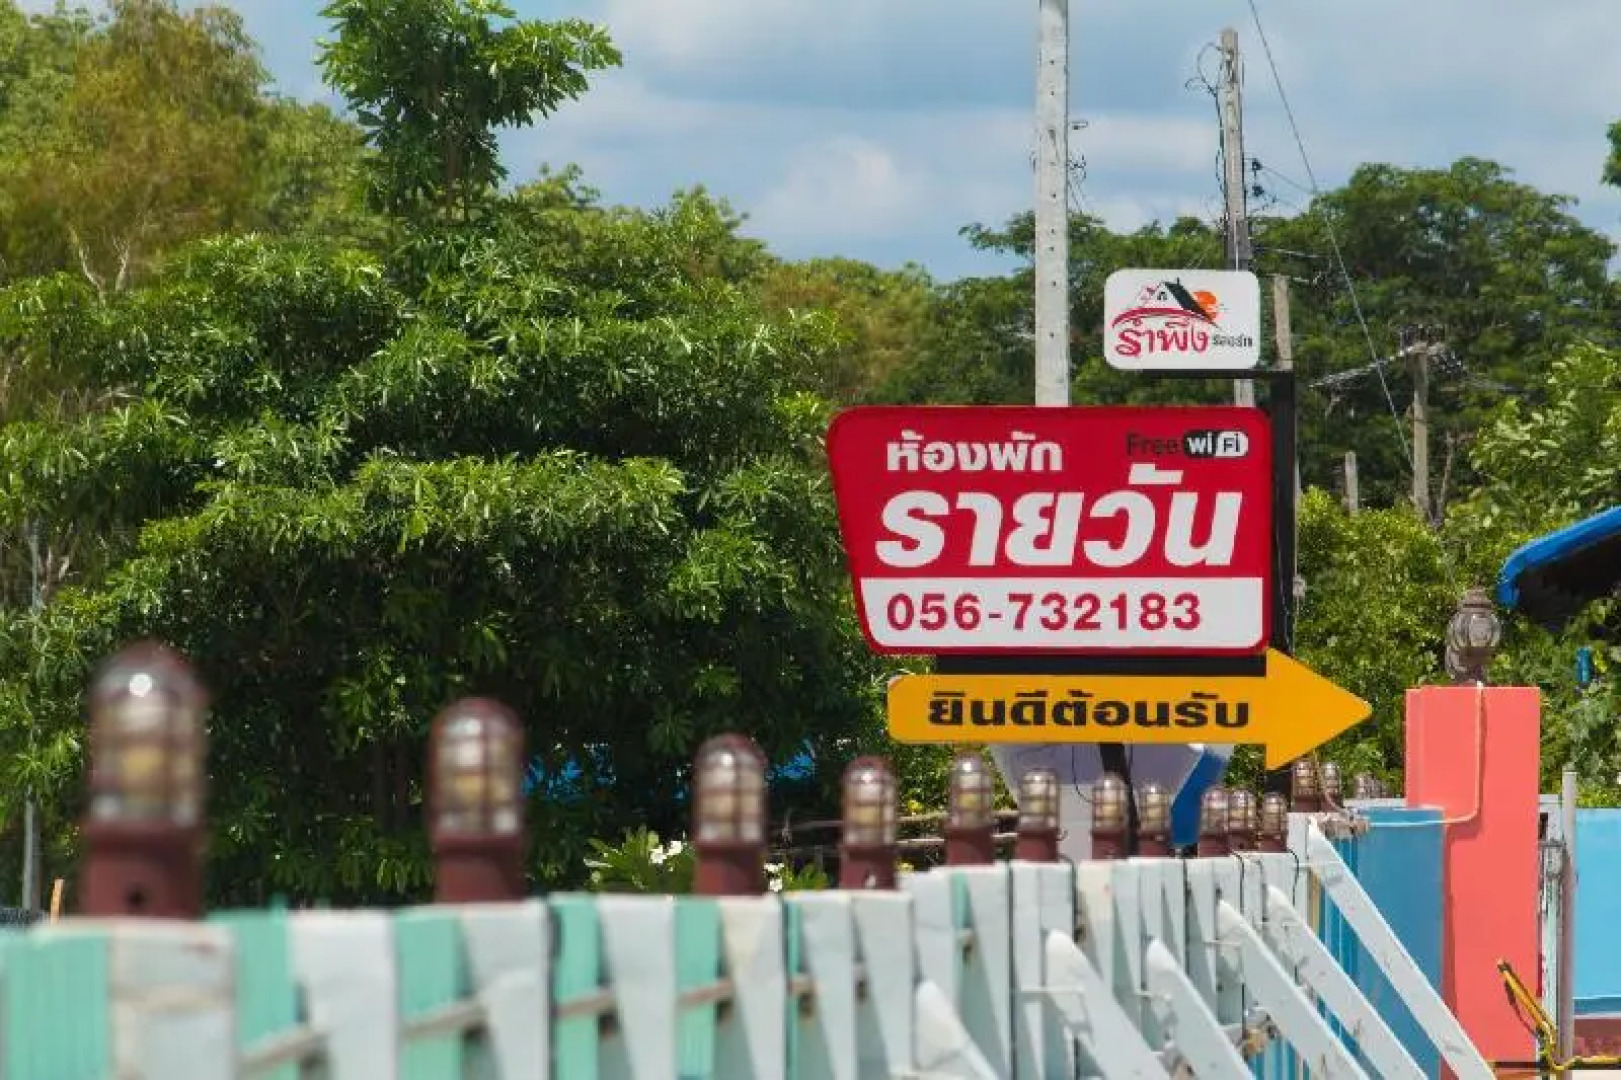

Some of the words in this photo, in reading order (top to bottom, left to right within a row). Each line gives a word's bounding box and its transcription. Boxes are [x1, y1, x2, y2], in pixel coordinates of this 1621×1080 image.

[886, 429, 1063, 472] ห้องพัก
[1126, 432, 1180, 455] Free
[875, 463, 1244, 568] รายวัน
[886, 592, 1202, 632] 056-732183
[928, 689, 1250, 729] ยินดีต้อนรับ
